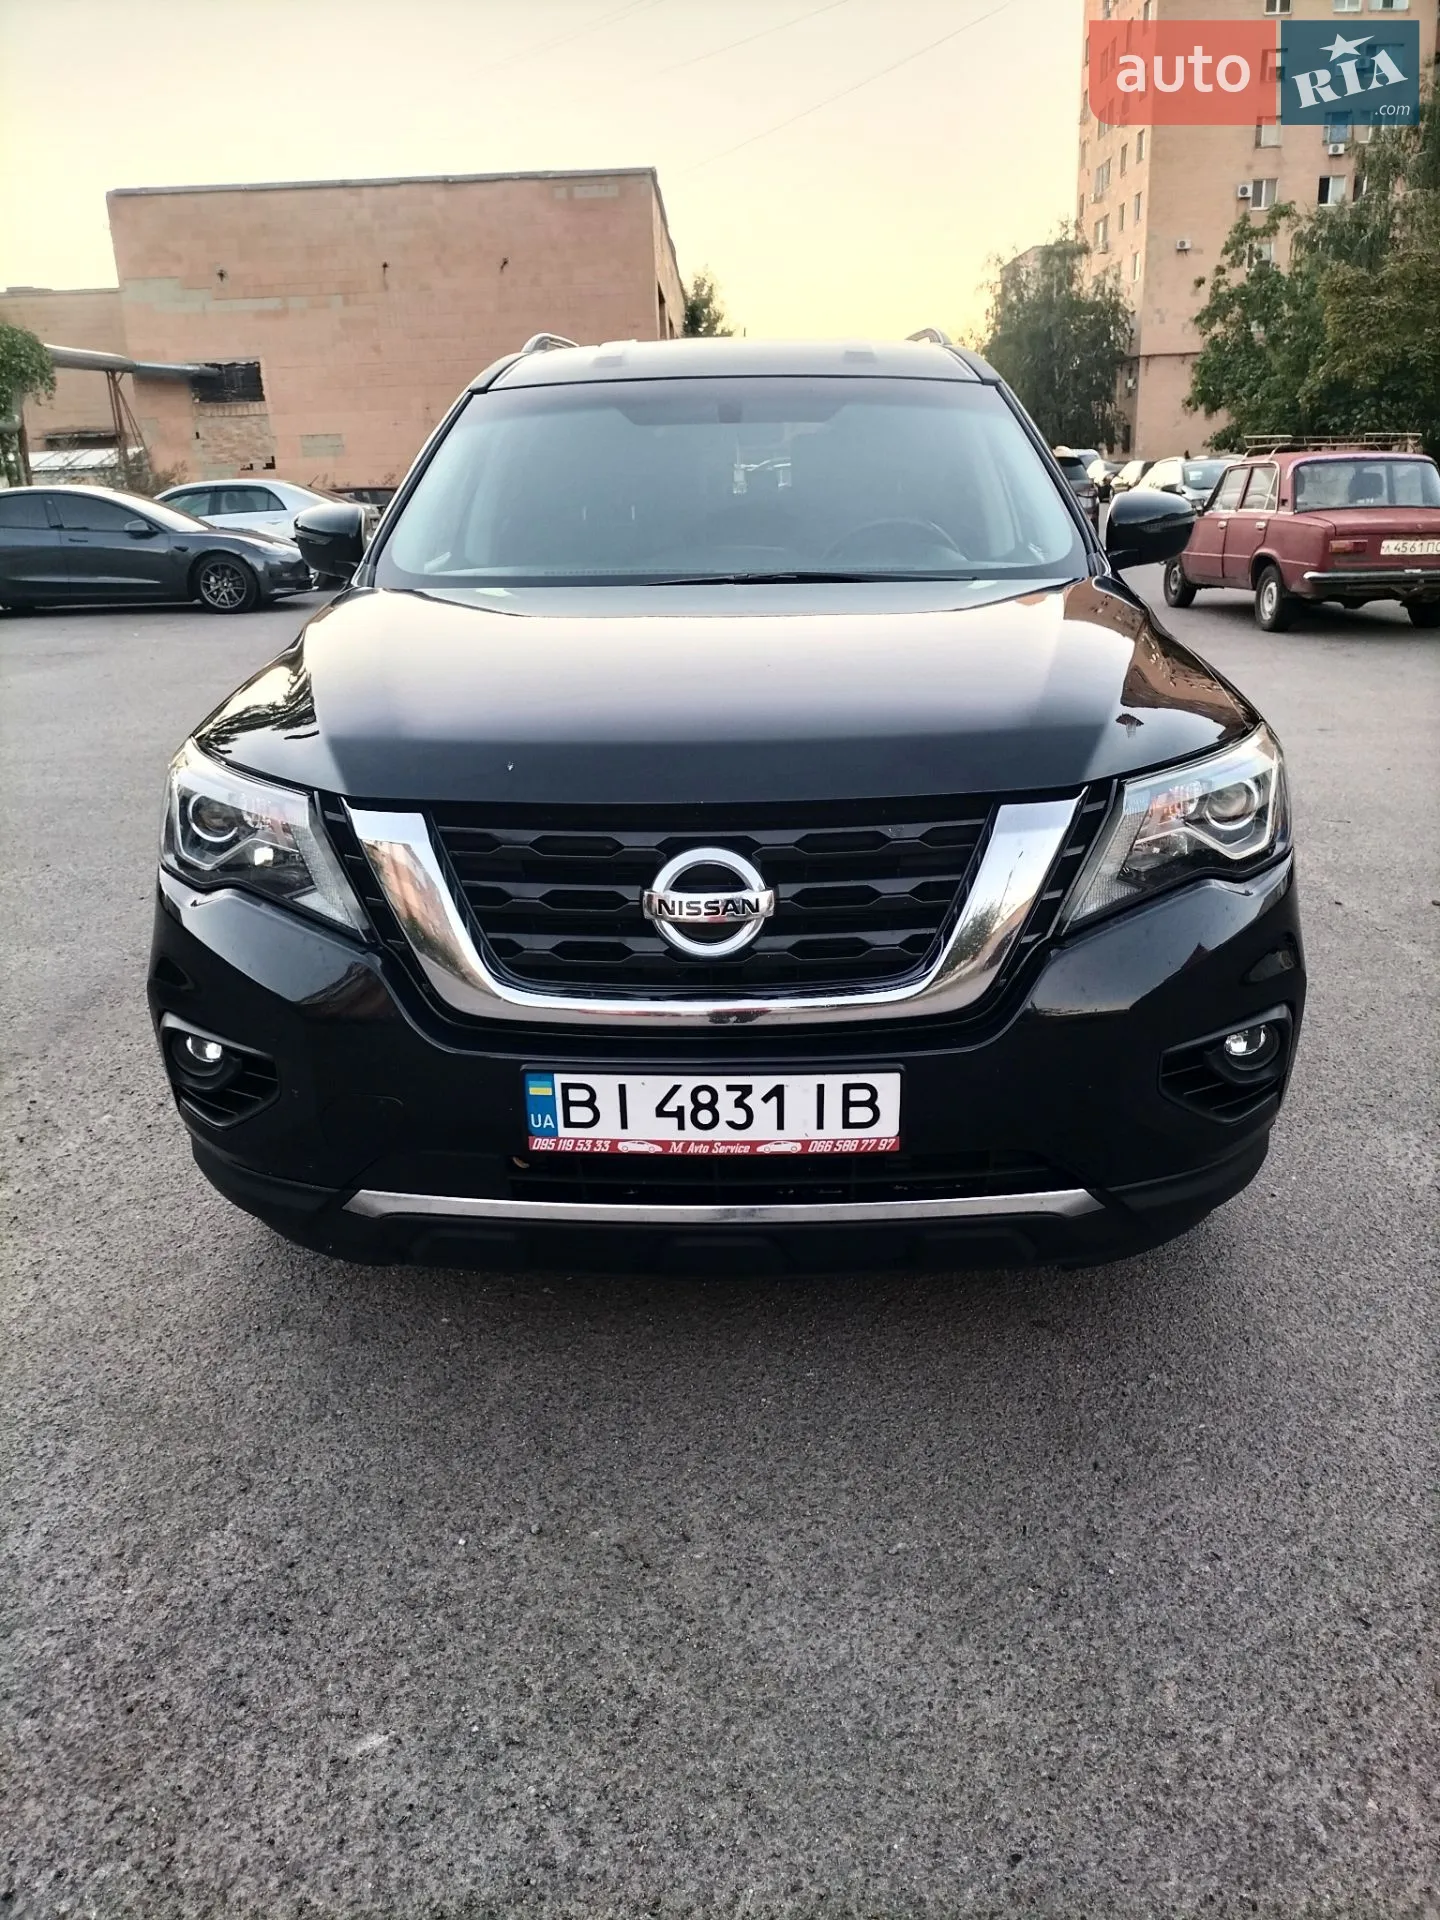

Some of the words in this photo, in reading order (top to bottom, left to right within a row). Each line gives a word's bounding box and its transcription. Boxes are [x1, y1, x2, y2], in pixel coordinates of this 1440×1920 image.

[657, 898, 760, 917] NISSAN
[560, 1082, 628, 1130] BI
[655, 1083, 786, 1131] 4831
[816, 1082, 881, 1130] IB
[530, 1113, 555, 1129] UA
[532, 1138, 556, 1150] 095
[557, 1139, 573, 1151] 119
[575, 1139, 591, 1152] 53
[593, 1140, 611, 1152] 33
[669, 1142, 684, 1153] M
[687, 1142, 709, 1154] Avto
[711, 1142, 750, 1154] Service
[808, 1140, 832, 1152] 066
[859, 1139, 876, 1151] 77
[877, 1138, 896, 1150] 97
